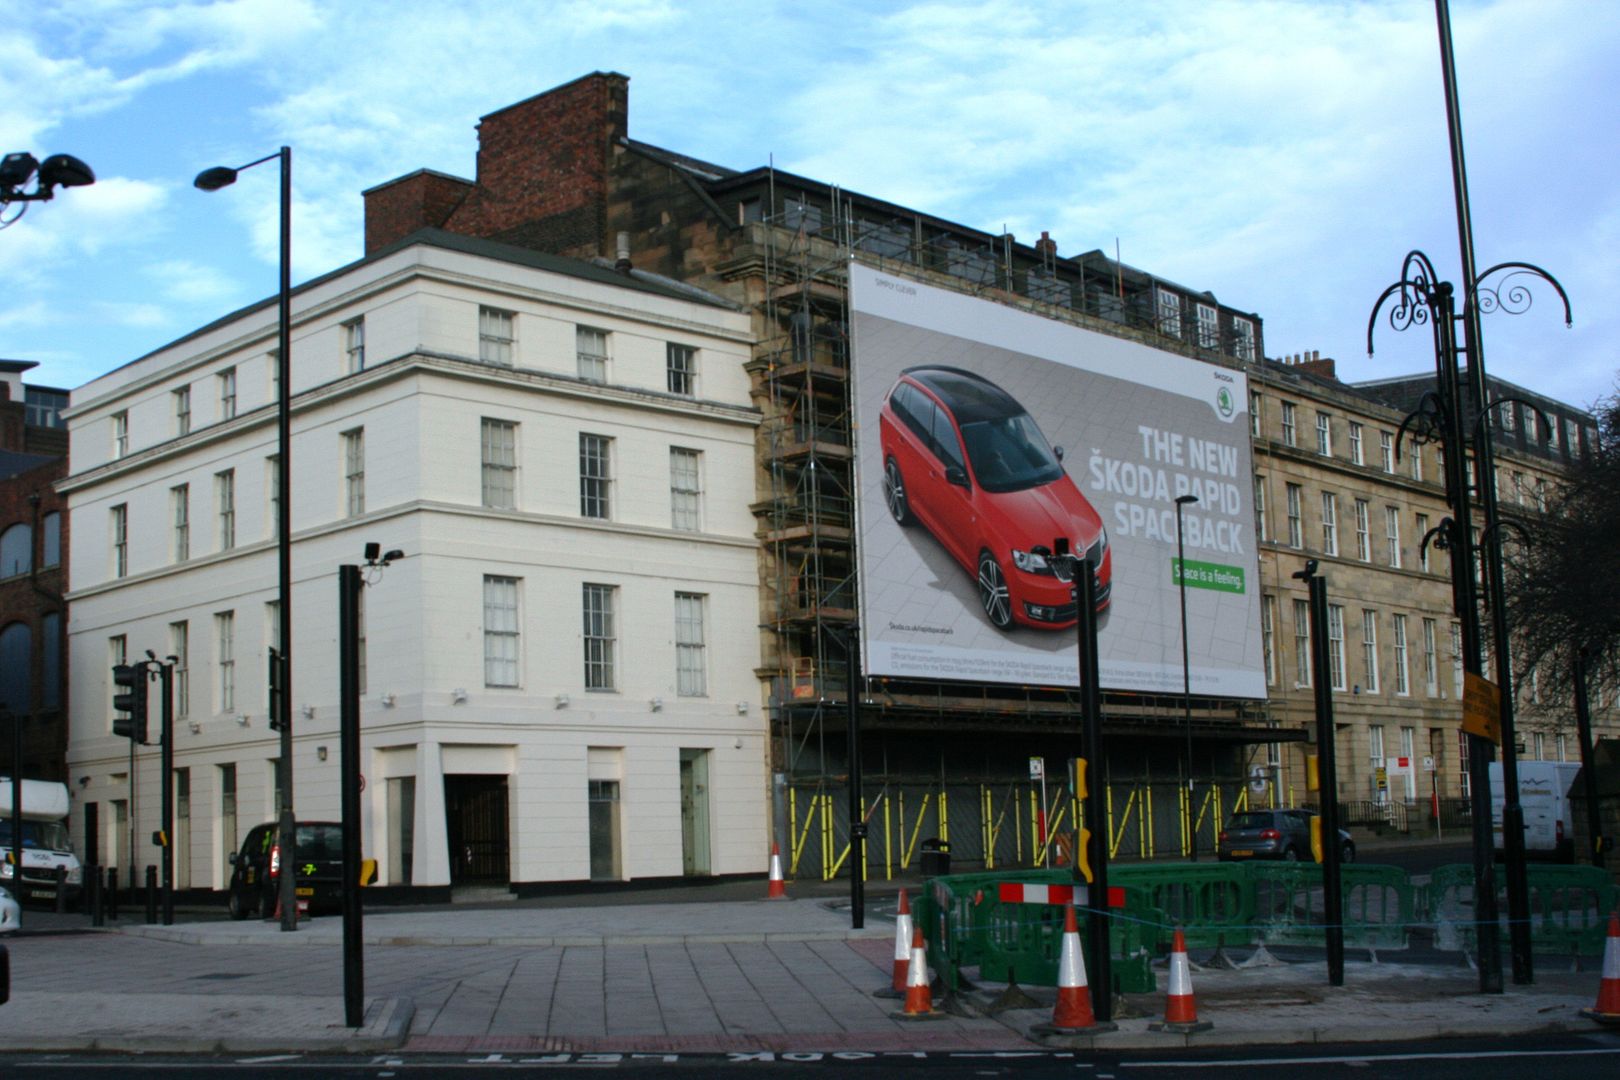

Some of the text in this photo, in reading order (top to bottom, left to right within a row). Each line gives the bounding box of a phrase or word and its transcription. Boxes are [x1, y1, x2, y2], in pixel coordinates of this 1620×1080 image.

[1138, 425, 1239, 478] THE NEW
[1089, 447, 1241, 516] ŠKODA RAPID
[1174, 564, 1199, 581] Sace
[1199, 567, 1207, 581] is
[1207, 571, 1214, 583] a
